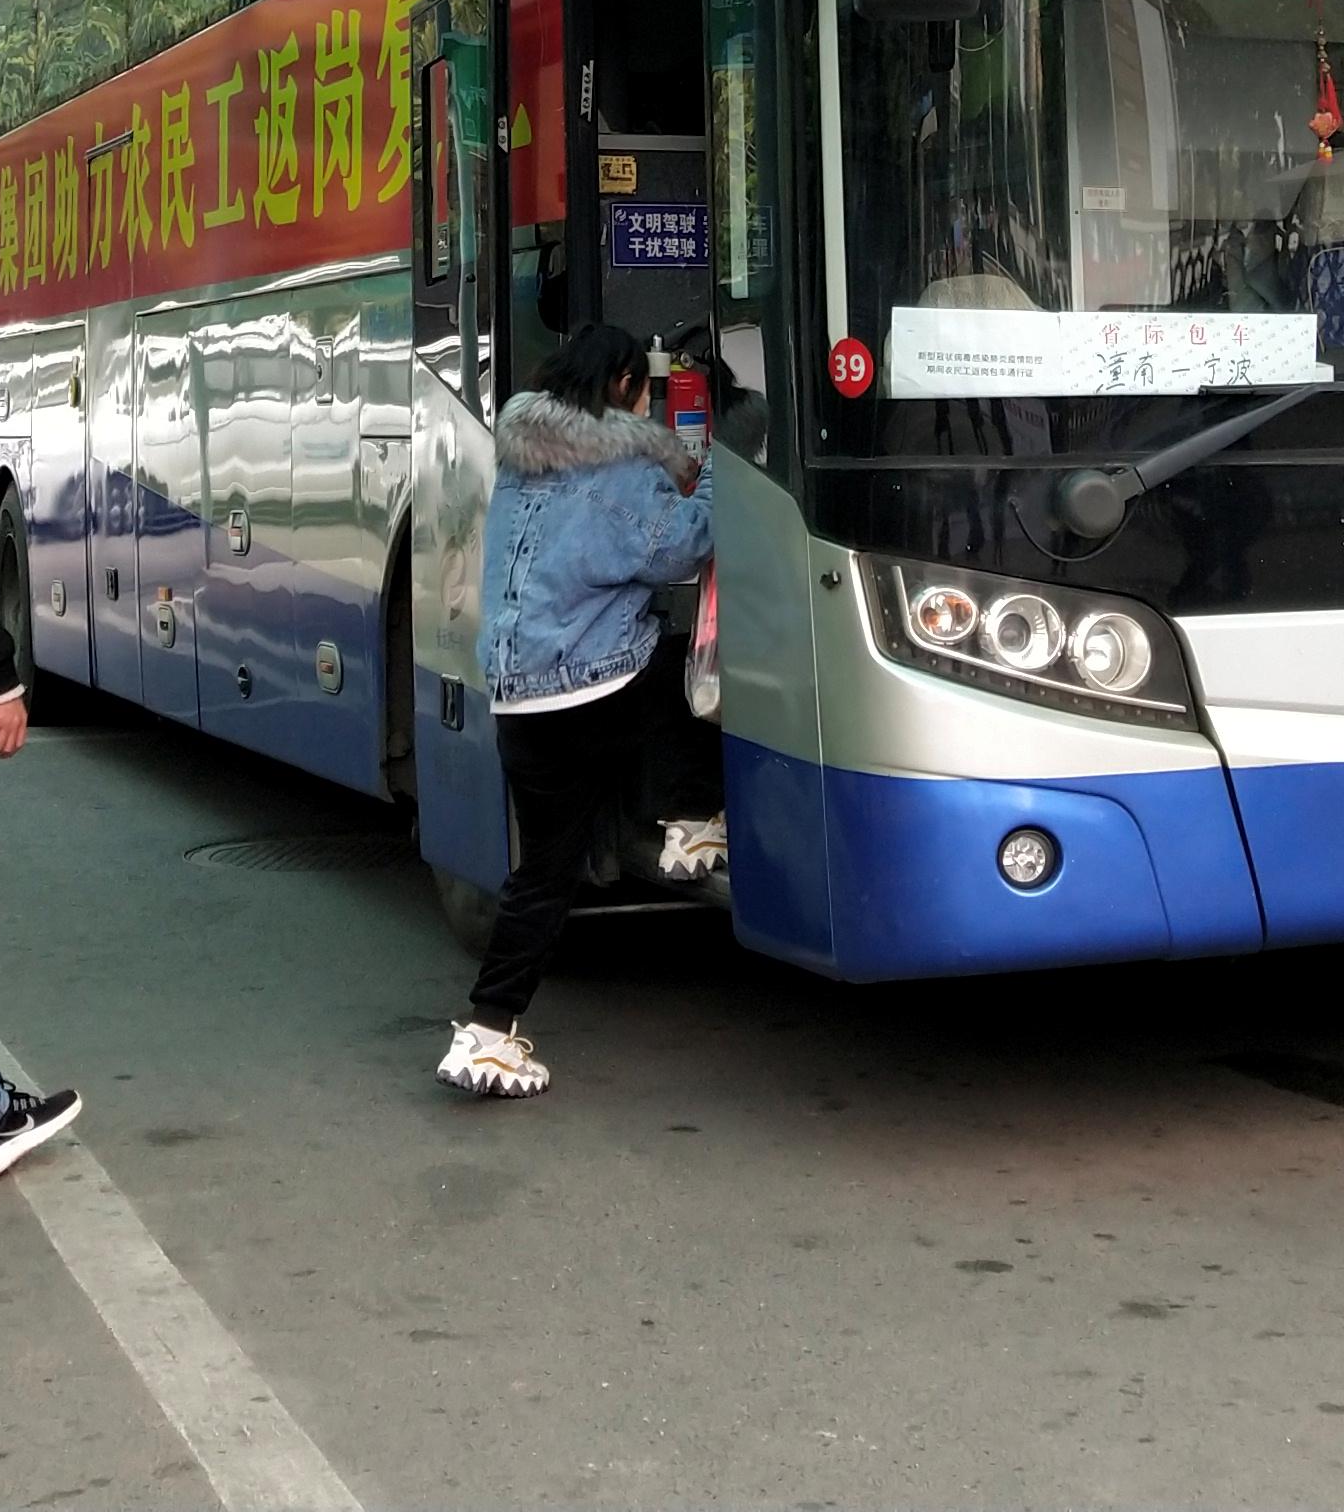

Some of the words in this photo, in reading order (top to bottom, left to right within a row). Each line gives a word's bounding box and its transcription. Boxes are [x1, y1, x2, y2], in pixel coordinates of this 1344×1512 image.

[628, 212, 696, 234] 文明驾驶
[1103, 323, 1250, 347] 省际包车
[833, 353, 868, 383] 39
